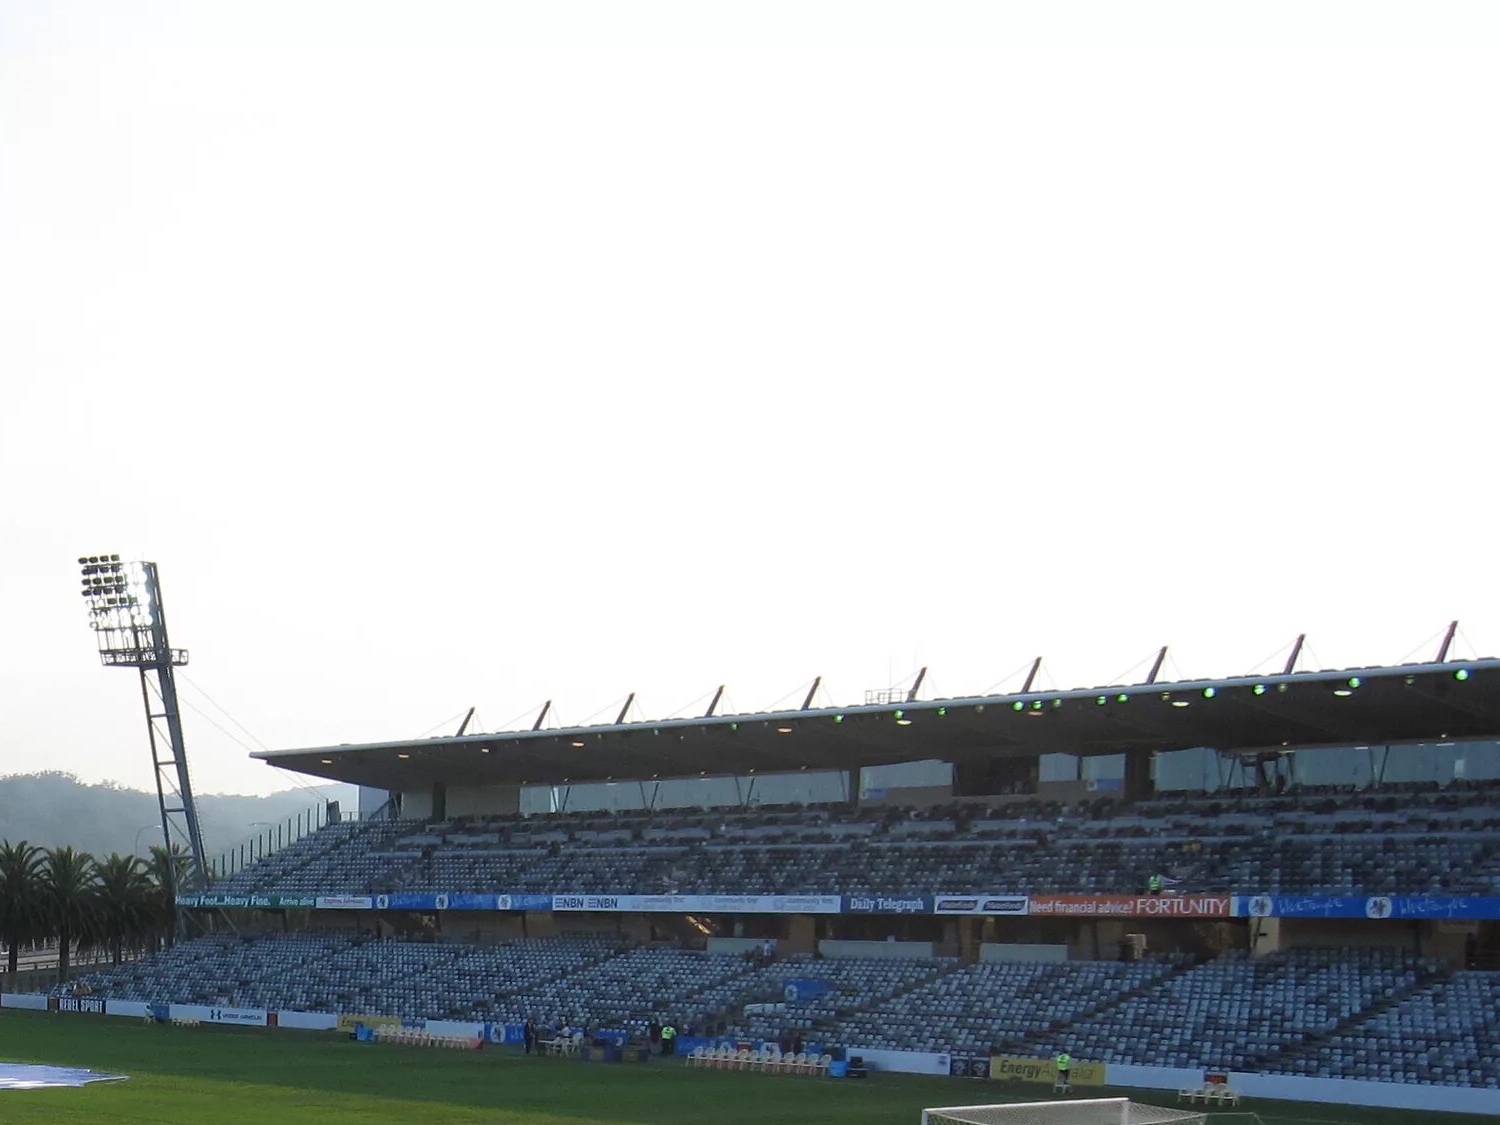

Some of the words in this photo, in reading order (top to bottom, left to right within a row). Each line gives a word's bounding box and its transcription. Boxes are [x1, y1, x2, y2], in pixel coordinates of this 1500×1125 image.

[563, 898, 584, 908] NBN
[596, 898, 618, 909] NBN
[850, 896, 874, 913] Daily
[877, 896, 924, 913] Telegraph
[1030, 900, 1053, 912] Need
[1055, 900, 1097, 912] financial
[1098, 900, 1133, 912] advice?
[59, 998, 79, 1011] REBEL
[80, 1000, 102, 1013] SPORT
